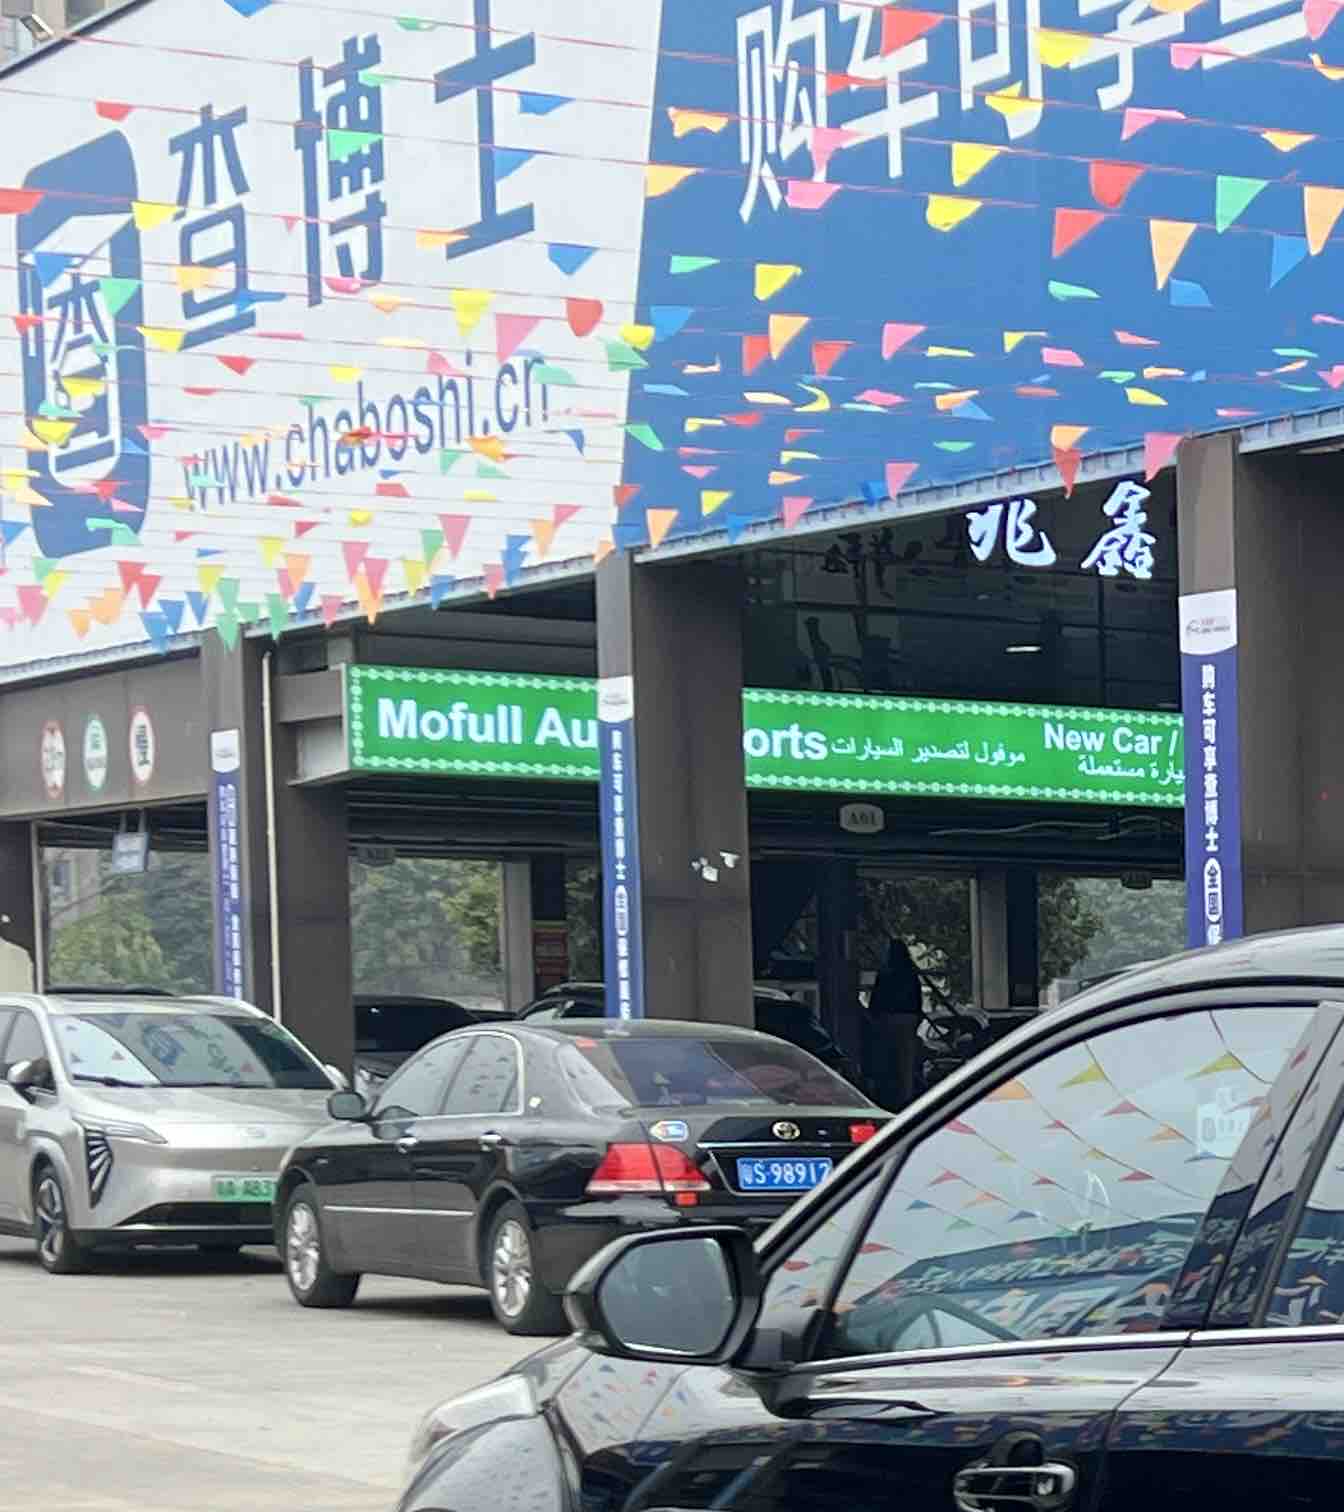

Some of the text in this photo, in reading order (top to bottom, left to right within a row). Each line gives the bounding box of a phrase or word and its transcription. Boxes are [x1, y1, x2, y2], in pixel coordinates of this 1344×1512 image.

[169, 0, 537, 351] 查博士
[184, 349, 549, 512] www.chaboshi.cn
[377, 696, 828, 761] Mofull Au orts
[1044, 722, 1105, 754] New
[1112, 727, 1162, 756] Car
